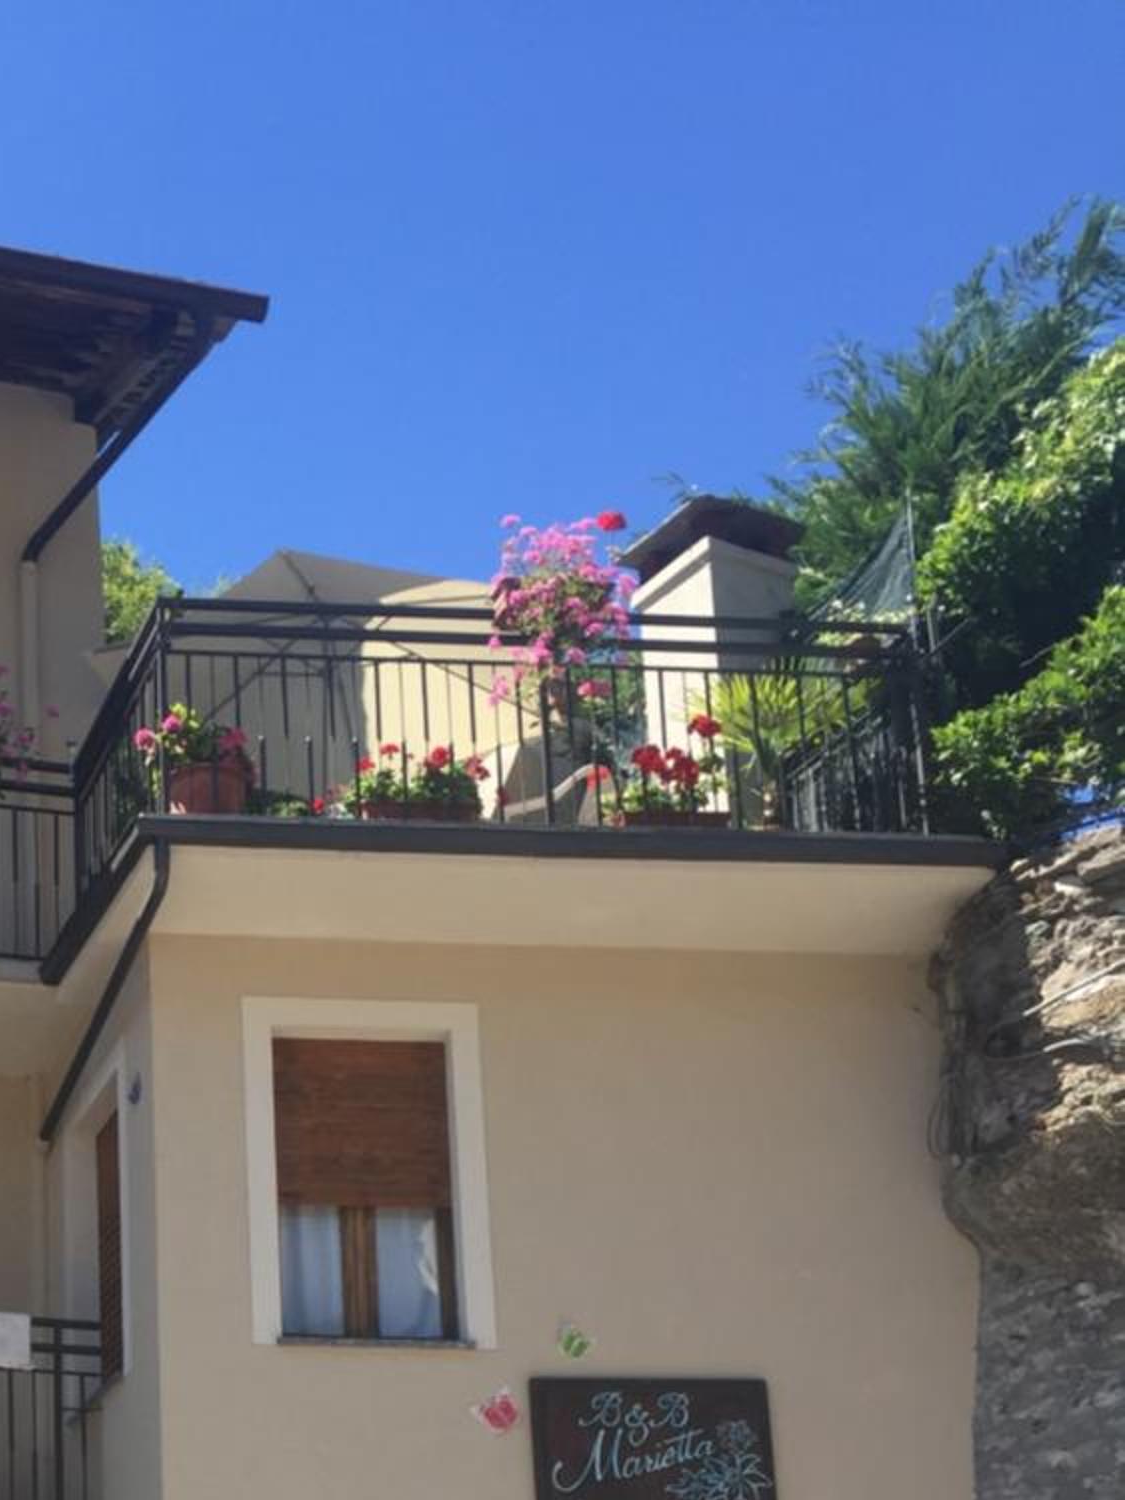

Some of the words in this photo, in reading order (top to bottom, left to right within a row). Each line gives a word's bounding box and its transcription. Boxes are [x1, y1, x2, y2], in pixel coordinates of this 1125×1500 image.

[578, 1391, 623, 1427] B
[624, 1402, 650, 1447] &
[649, 1391, 690, 1428] B
[552, 1427, 715, 1493] Marietta
